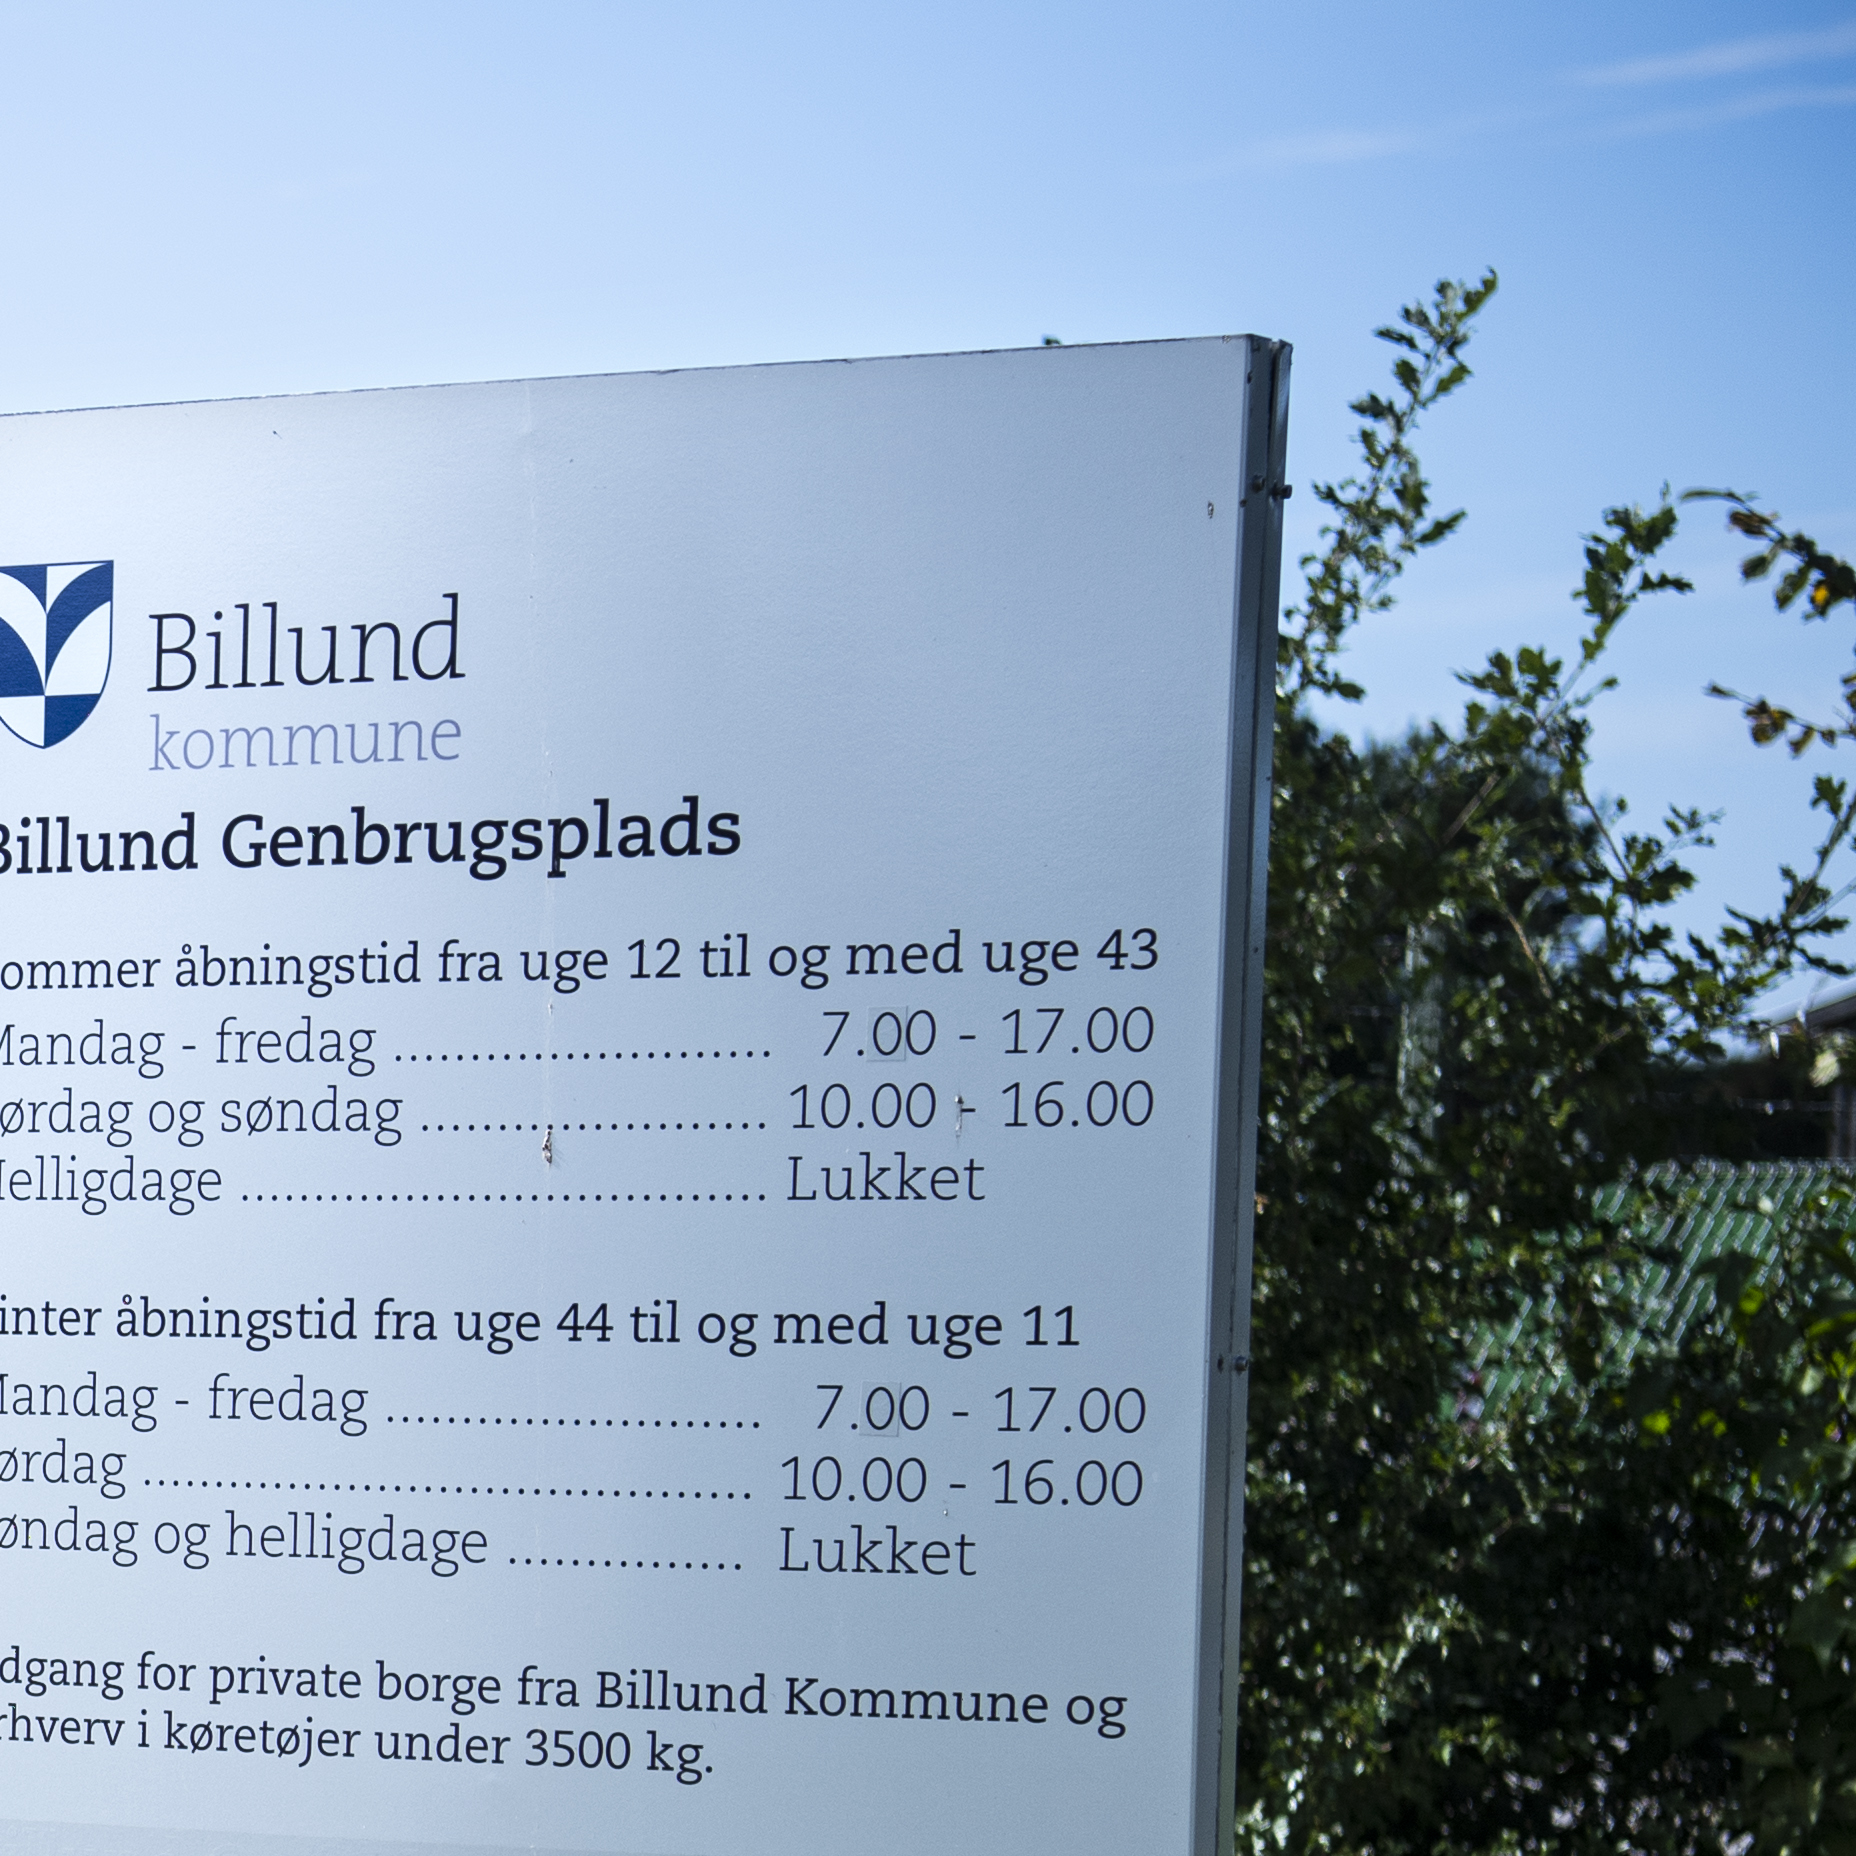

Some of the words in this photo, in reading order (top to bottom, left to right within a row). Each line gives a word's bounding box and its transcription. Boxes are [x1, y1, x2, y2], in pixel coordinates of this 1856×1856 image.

[147, 592, 466, 692] Billund
[149, 714, 461, 770] kommune
[222, 795, 741, 882] Genbrugsplads
[176, 940, 422, 999] åbningstid
[438, 939, 504, 983] fra
[520, 950, 609, 995] uge
[628, 938, 681, 980] 12
[700, 933, 752, 979] til
[769, 945, 831, 991] og
[846, 929, 964, 976] med
[982, 940, 1080, 987] uge
[1097, 928, 1159, 971] 43
[216, 1016, 377, 1078] fredag
[823, 1010, 937, 1057] 7.00
[1002, 1006, 1155, 1055] 17.00
[149, 1100, 206, 1148] og
[221, 1085, 404, 1147] søndag
[790, 1082, 937, 1130] 10.00
[1002, 1080, 1154, 1128] 16.00
[787, 1151, 986, 1202] Lukket
[117, 1294, 358, 1353] åbningstid
[374, 1297, 439, 1341] fra
[454, 1312, 541, 1356] uge
[557, 1303, 615, 1343] 44
[630, 1299, 681, 1344] til
[698, 1313, 759, 1358] og
[774, 1301, 889, 1346] med
[907, 1315, 1003, 1360] uge
[1023, 1305, 1081, 1347] 11
[209, 1373, 369, 1438] fredag
[817, 1385, 930, 1432] 7.00
[995, 1387, 1146, 1434] 17.00
[782, 1456, 927, 1503] 10.00
[992, 1459, 1143, 1507] 16.00
[155, 1522, 211, 1570] og
[225, 1510, 488, 1578] helligdage
[779, 1525, 977, 1577] Lukket
[137, 1651, 197, 1692] for
[209, 1655, 362, 1706] private
[376, 1660, 502, 1717] borge
[518, 1665, 581, 1708] fra
[596, 1669, 769, 1715] Billund
[785, 1677, 1049, 1724] Kommune
[1067, 1696, 1129, 1740] og
[138, 1709, 151, 1748] i
[163, 1710, 362, 1768] køretøjer
[374, 1722, 512, 1765] under
[526, 1729, 631, 1770] 3500
[646, 1730, 713, 1786] kg.
